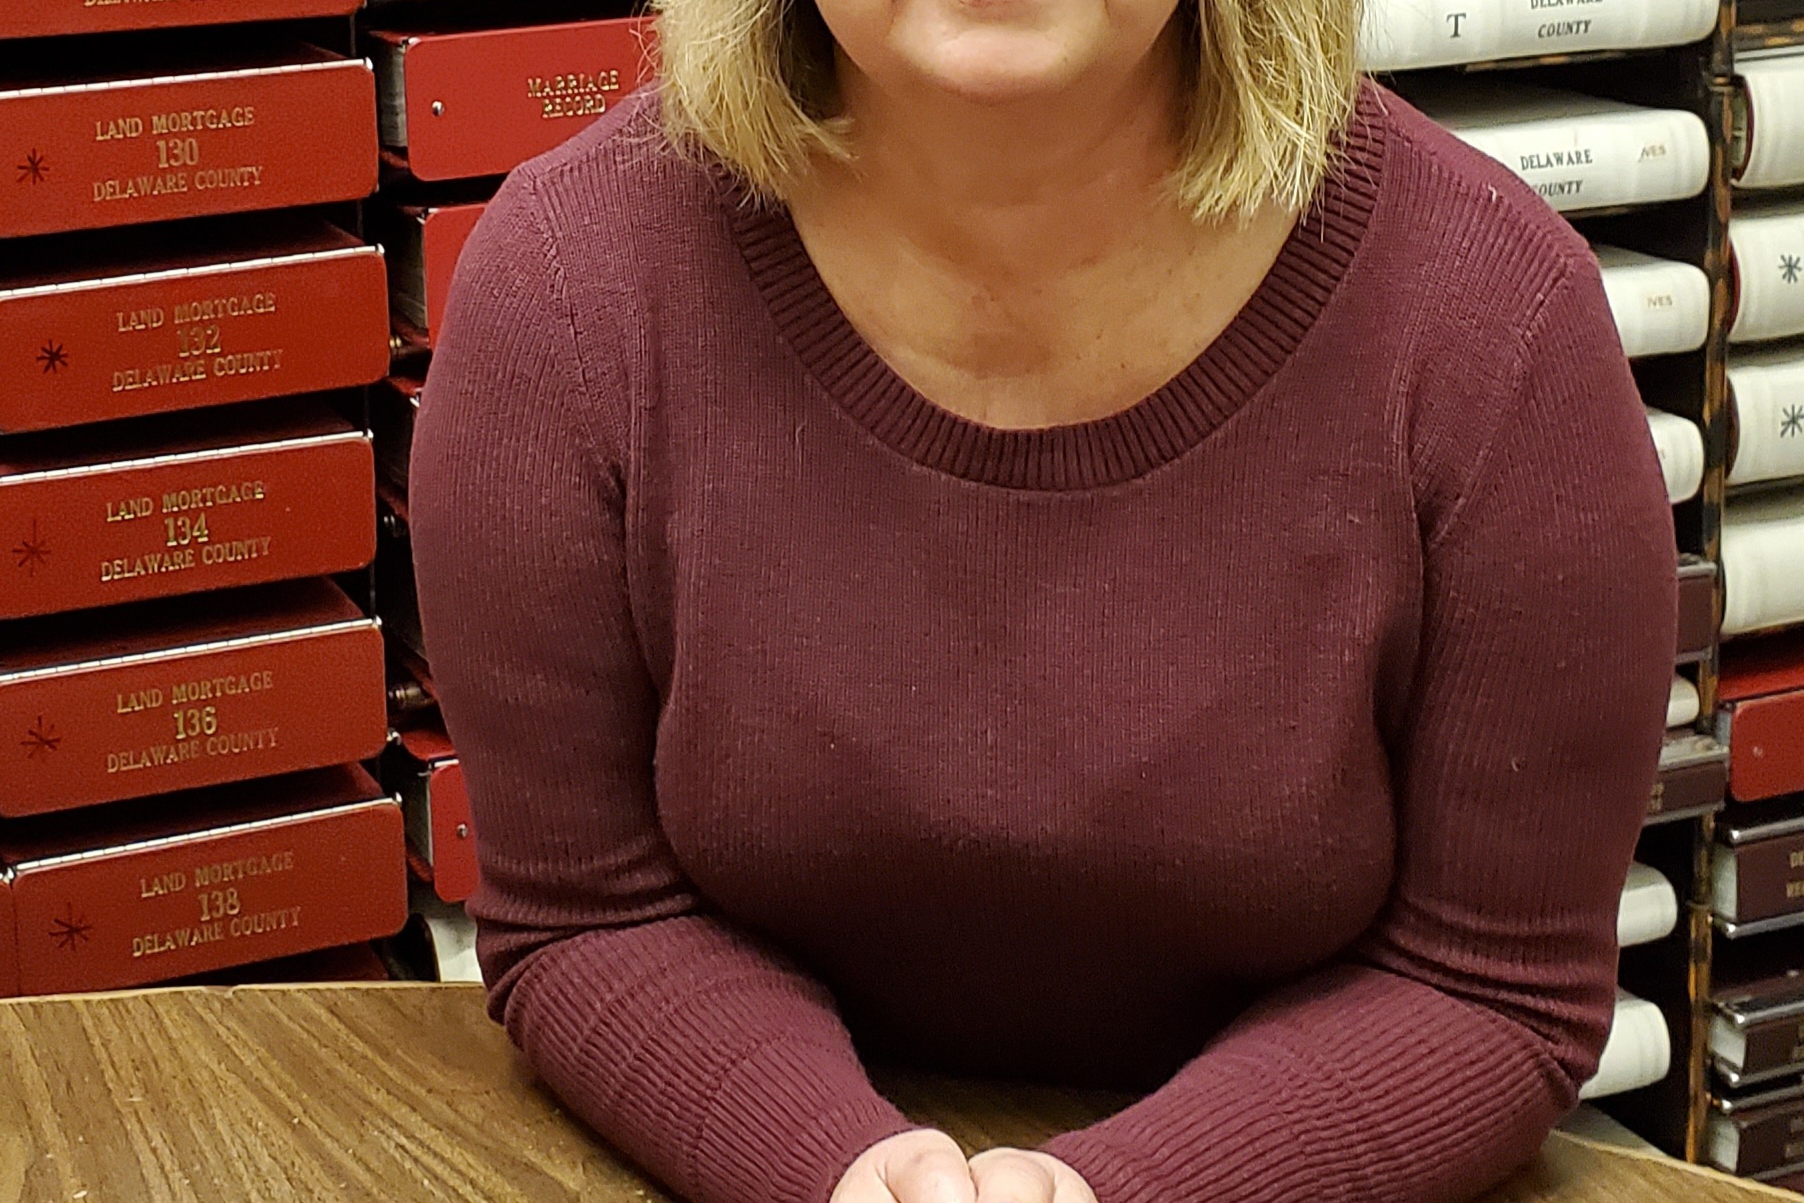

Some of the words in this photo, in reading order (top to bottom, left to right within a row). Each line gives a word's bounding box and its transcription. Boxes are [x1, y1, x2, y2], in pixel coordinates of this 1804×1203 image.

[1446, 13, 1467, 38] T
[1538, 19, 1591, 39] COUNTY
[527, 69, 620, 99] MARRIAGE
[542, 93, 606, 119] RECORD
[95, 116, 143, 142] LAND
[151, 106, 255, 135] MORTGAGE
[156, 137, 199, 169] 130
[1520, 149, 1593, 171] DELAWARE
[93, 173, 188, 202] DELAWARE
[195, 166, 263, 191] COUNTY
[1533, 180, 1583, 197] OUNTY
[116, 307, 165, 333] LAND
[174, 293, 276, 325] MORTGAGE
[177, 325, 221, 358] 132
[112, 360, 207, 392] DELAWARE
[214, 349, 283, 377] COUNTY
[106, 497, 153, 523] LAND
[162, 481, 265, 514] MORTGAGE
[164, 513, 209, 547] 134
[101, 549, 195, 582] DELAWARE
[202, 536, 271, 566] COUNTY
[116, 688, 163, 714] LAND
[171, 671, 274, 705] MORTGAGE
[173, 706, 218, 740] 136
[107, 740, 199, 774] DELAWARE
[207, 727, 279, 757] COUNTY
[140, 871, 187, 898] LAND
[194, 851, 295, 889] MORTGAGE
[199, 887, 241, 922] 138
[132, 922, 225, 957] DELAWARE
[230, 905, 301, 938] COUNTY
